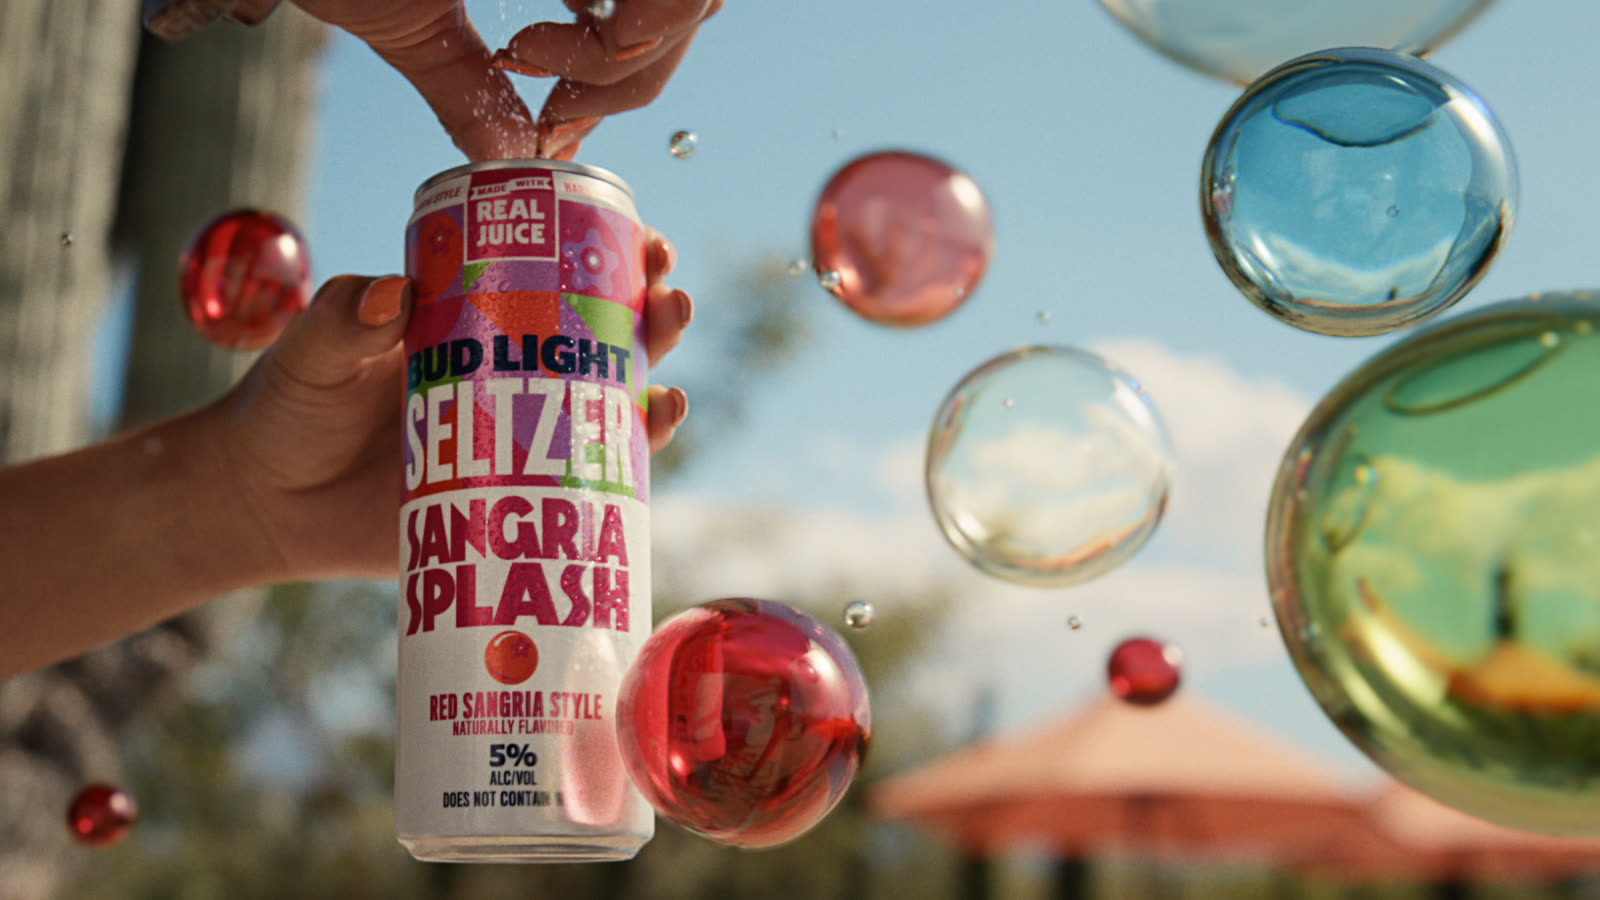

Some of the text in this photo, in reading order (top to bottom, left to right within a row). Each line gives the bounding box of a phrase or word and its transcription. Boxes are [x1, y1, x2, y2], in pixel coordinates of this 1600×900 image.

[478, 179, 544, 195] MADE WITH
[477, 199, 545, 222] REAL
[477, 223, 545, 246] JUICE
[407, 335, 630, 390] BUD LIGHT
[406, 377, 633, 491] SELTZER
[407, 496, 629, 572] SANGRIA
[406, 562, 630, 637] SPLASH
[430, 691, 602, 721] RED SANGRIA STYLE
[453, 719, 514, 736] NATURALLY
[490, 743, 537, 768] 5%
[490, 770, 537, 786] ALC/VOL
[443, 792, 470, 808] DOES
[474, 791, 496, 807] NOT
